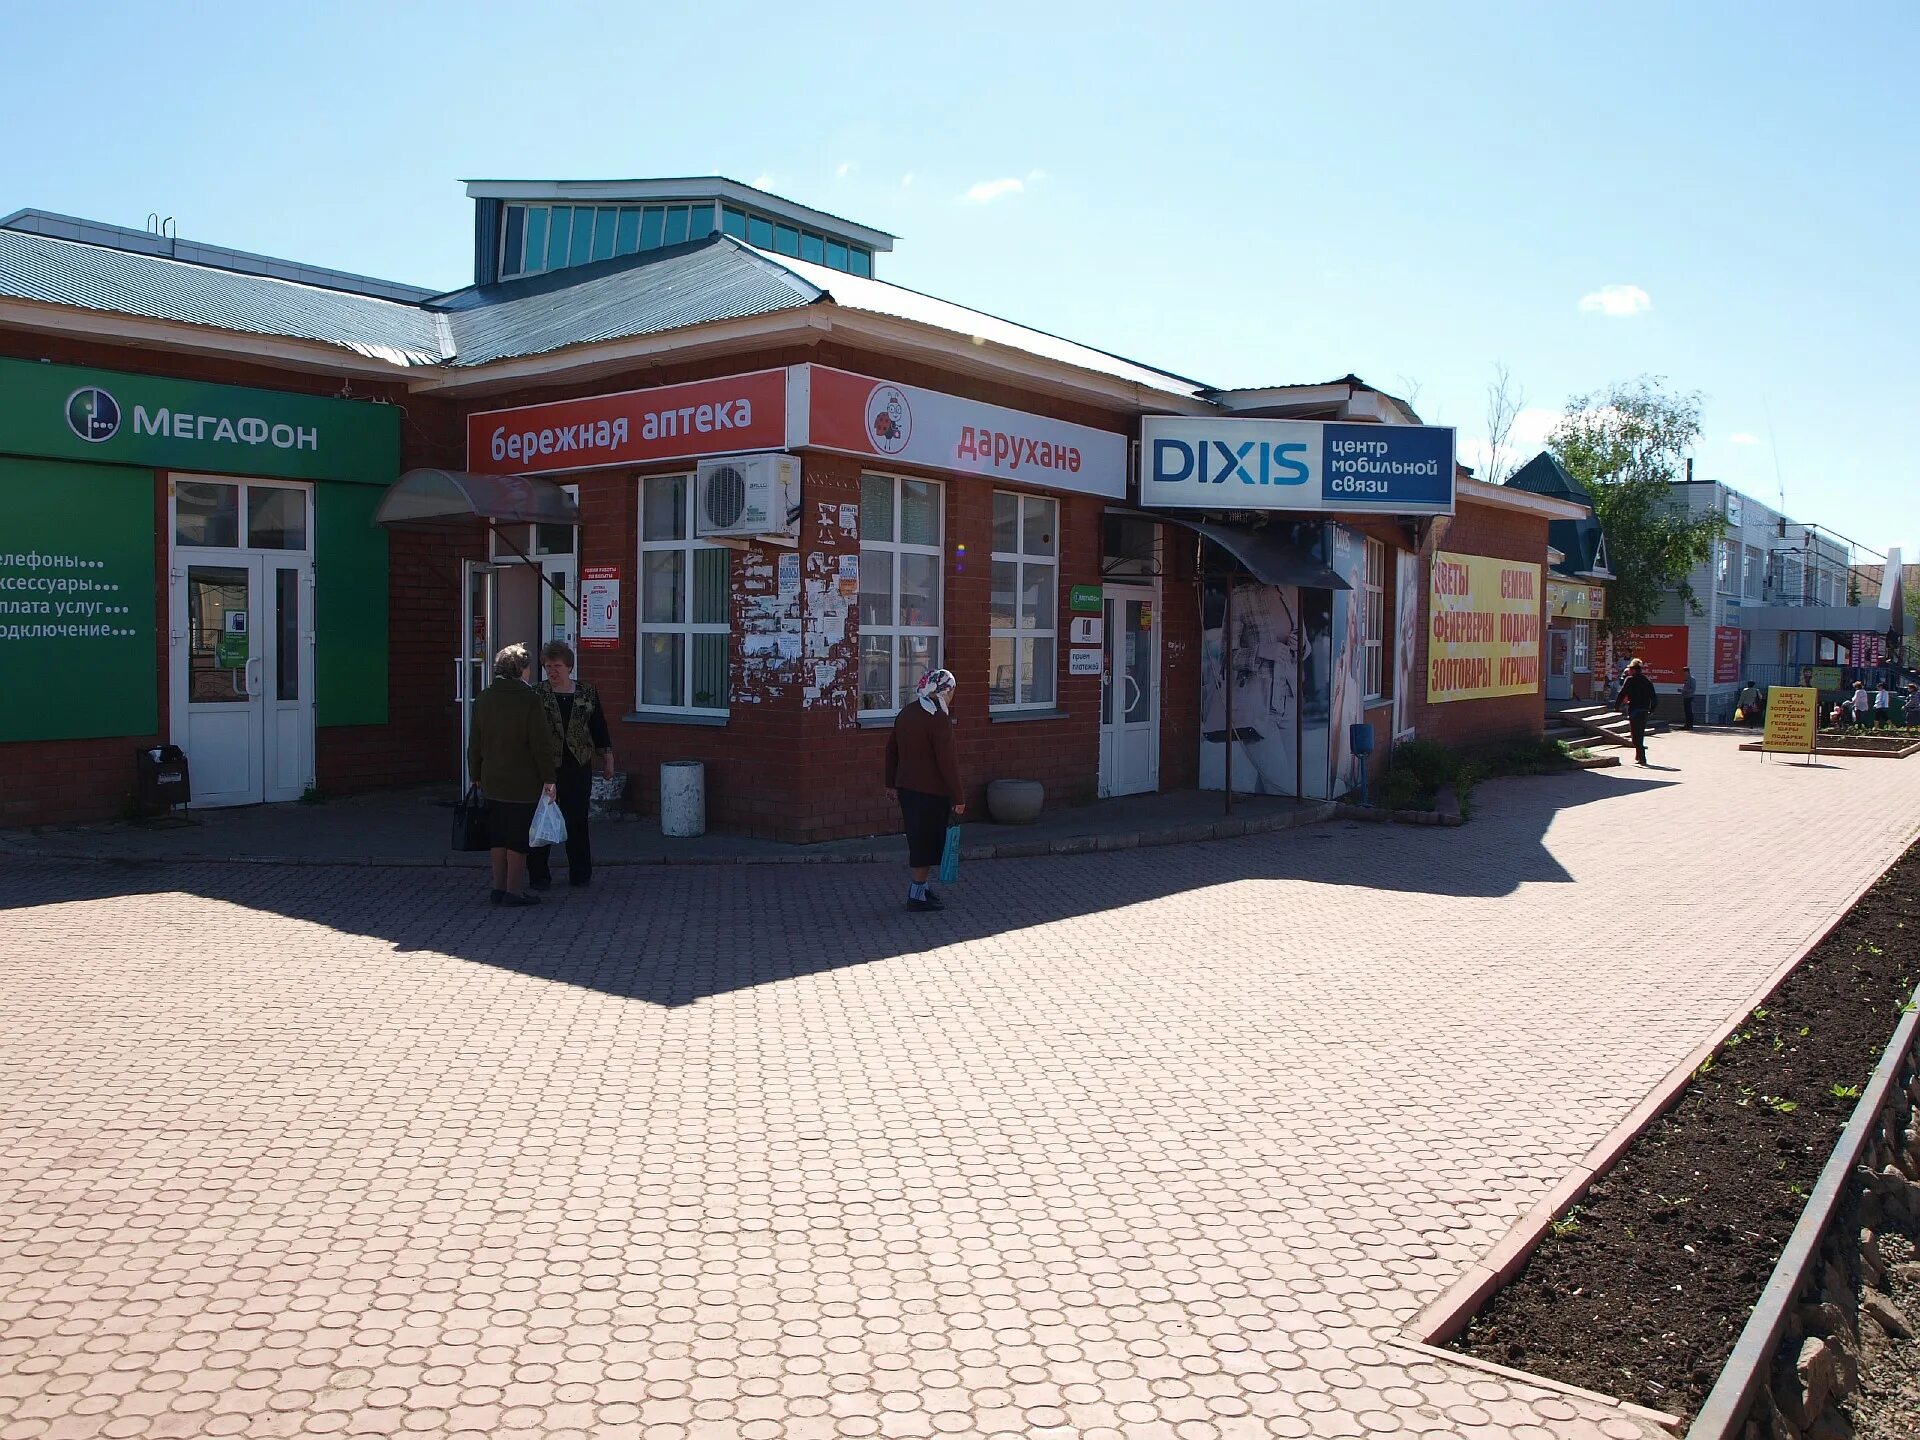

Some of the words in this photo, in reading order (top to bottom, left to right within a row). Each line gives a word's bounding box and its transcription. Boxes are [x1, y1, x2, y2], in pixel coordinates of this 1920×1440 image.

[490, 416, 629, 465] бережная
[641, 397, 752, 441] аптека
[957, 425, 1082, 473] даруханә
[1331, 438, 1389, 458] центр
[1152, 438, 1310, 486] DIXIS
[1331, 457, 1438, 476] мобильной
[1331, 477, 1389, 494] связи
[0, 550, 104, 571] лефоны...
[1434, 561, 1469, 599] ЦВЕТЫ
[1501, 568, 1534, 600] СЕМЕНА
[1433, 603, 1494, 643] ФЕЙЕРВЕРКИ
[1500, 612, 1539, 647] ПОДАРКИ
[1431, 657, 1492, 692] ЗООТОВАРЫ
[1499, 655, 1538, 686] ИГРУШКИ
